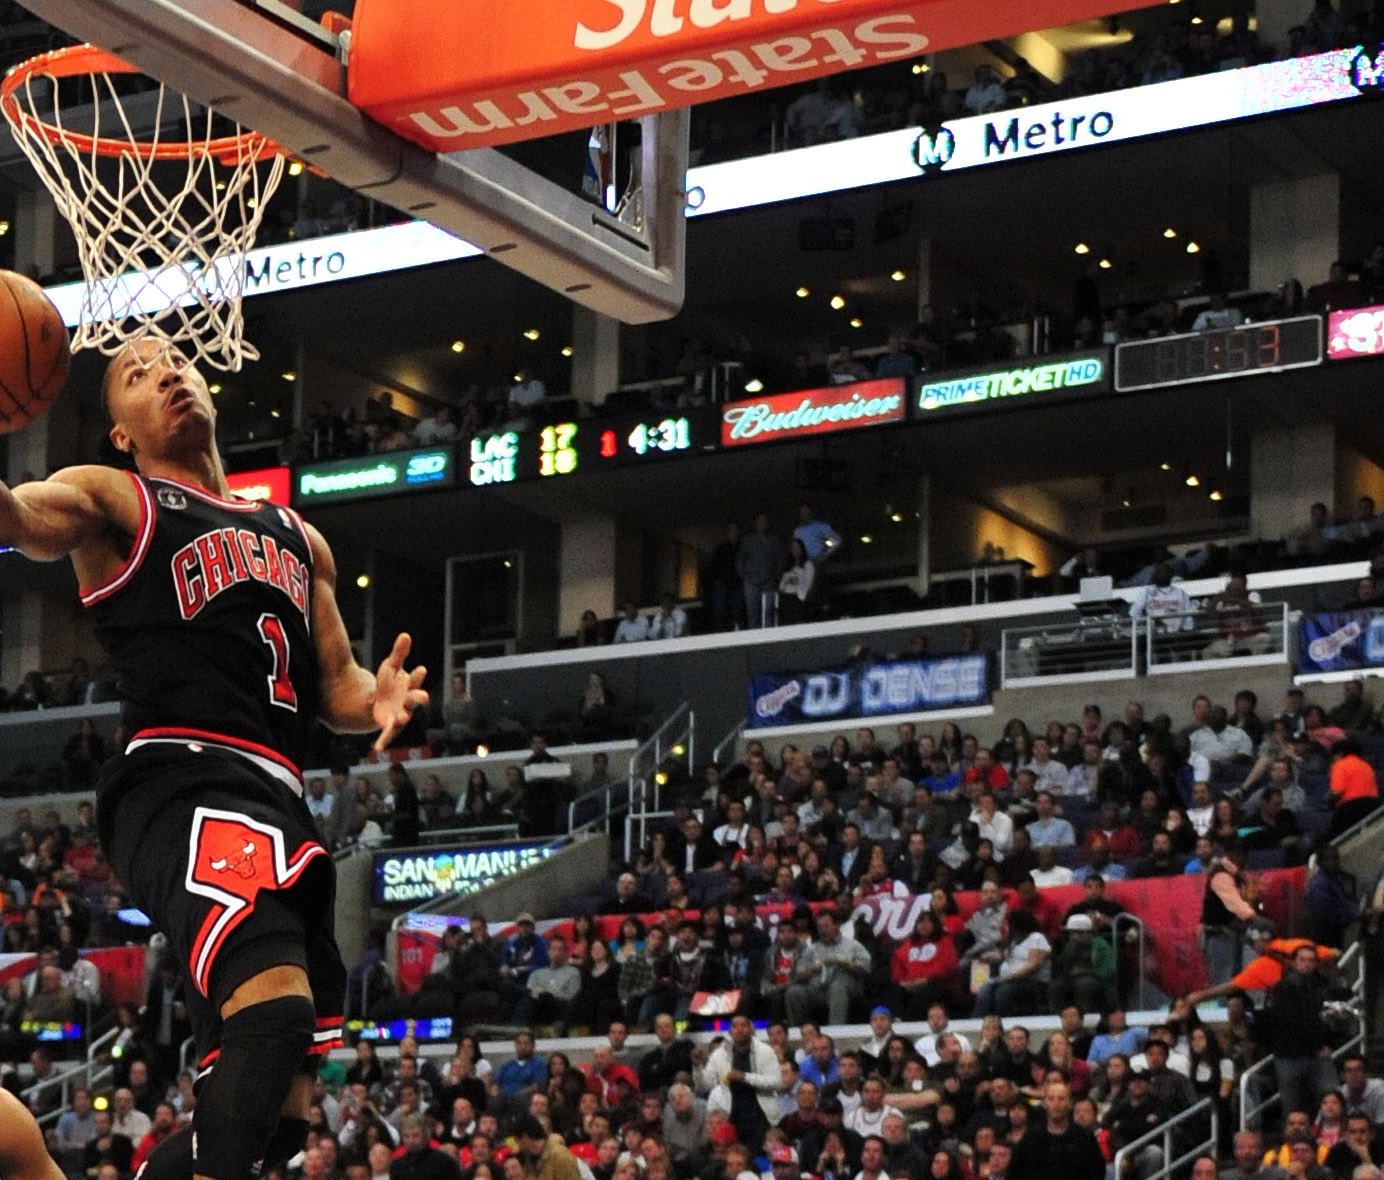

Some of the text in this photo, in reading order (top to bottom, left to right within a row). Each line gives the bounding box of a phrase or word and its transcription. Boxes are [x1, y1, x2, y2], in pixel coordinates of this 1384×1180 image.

[409, 13, 930, 138] State Farm
[983, 110, 1115, 159] Metro
[244, 251, 345, 289] Metro
[724, 393, 903, 439] Budweiser
[471, 417, 690, 462] LAC 17 1 4:31
[256, 612, 297, 713] 1
[862, 654, 986, 712] DENSE
[384, 856, 435, 884] SAN
[384, 883, 434, 900] INDIAN
